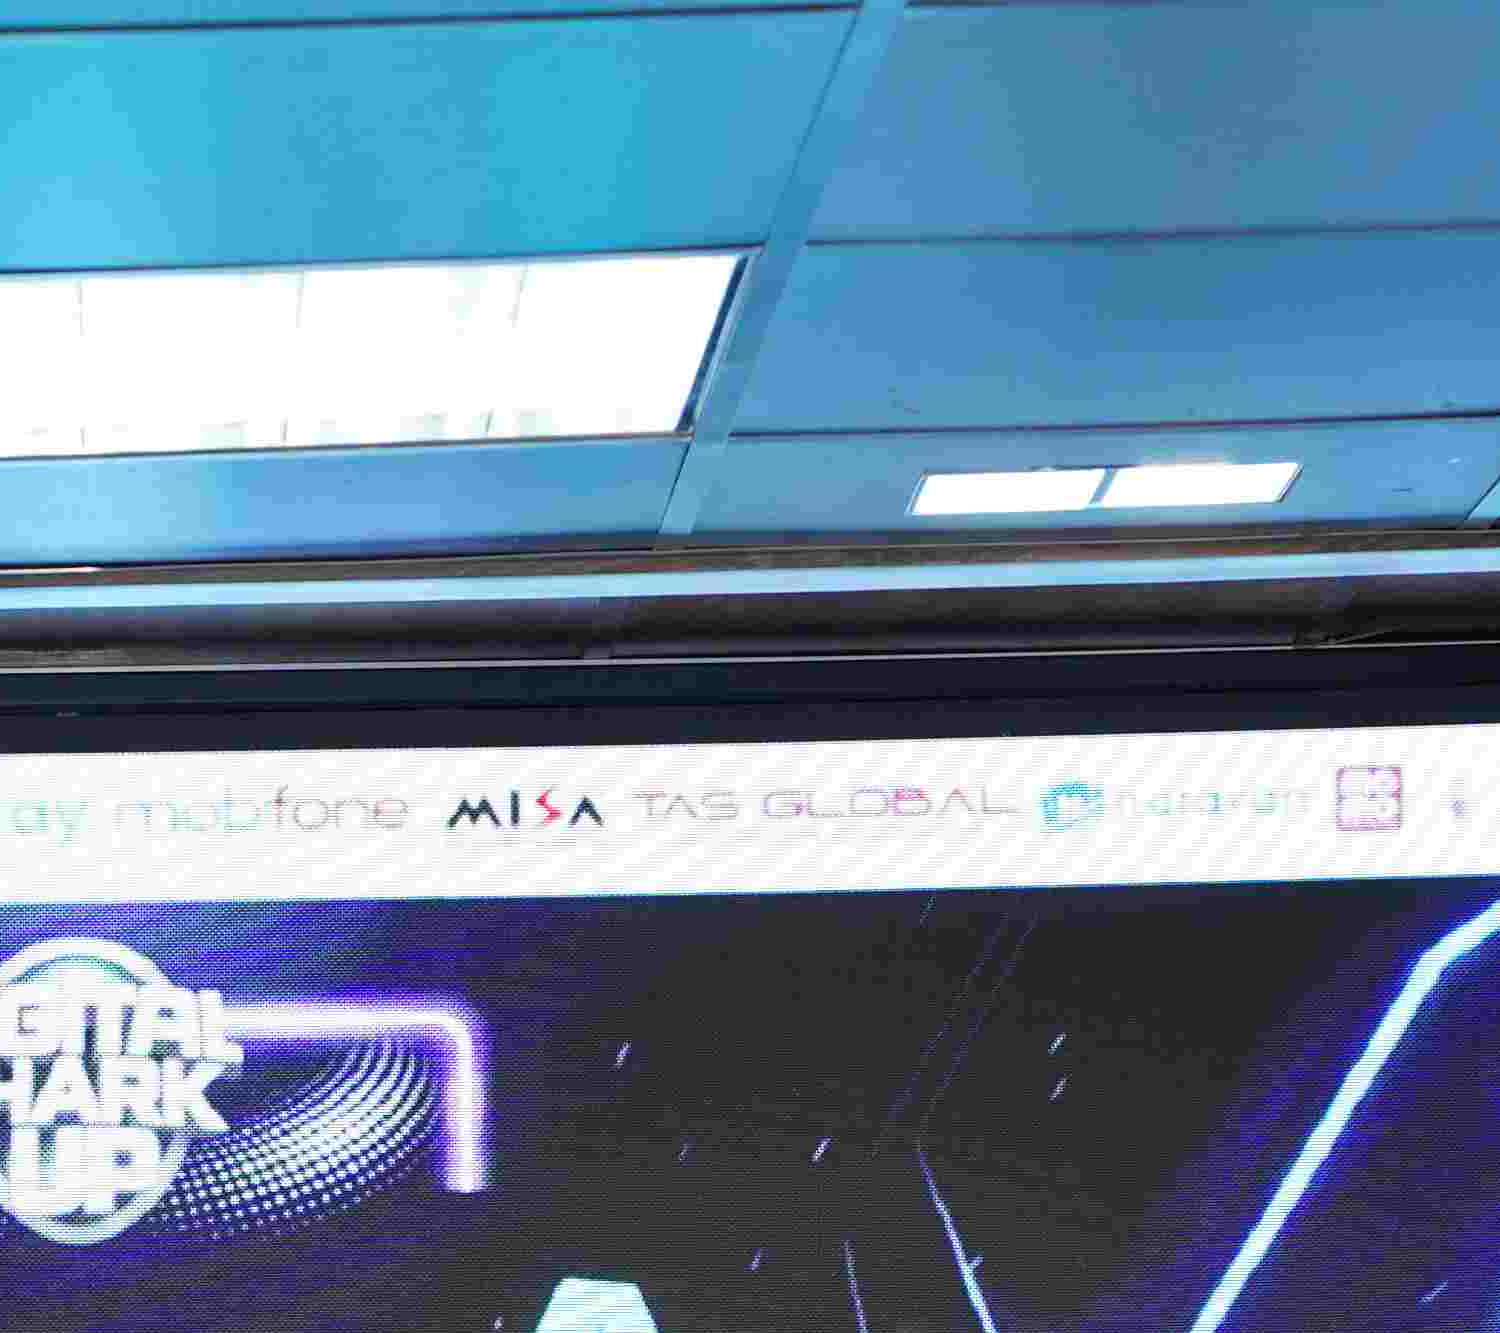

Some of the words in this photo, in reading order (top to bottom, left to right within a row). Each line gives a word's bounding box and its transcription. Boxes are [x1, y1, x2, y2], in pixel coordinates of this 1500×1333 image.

[447, 786, 604, 830] MISA
[636, 788, 740, 822] TAS
[760, 784, 1020, 820] GLOBAL
[0, 1124, 172, 1220] UP
